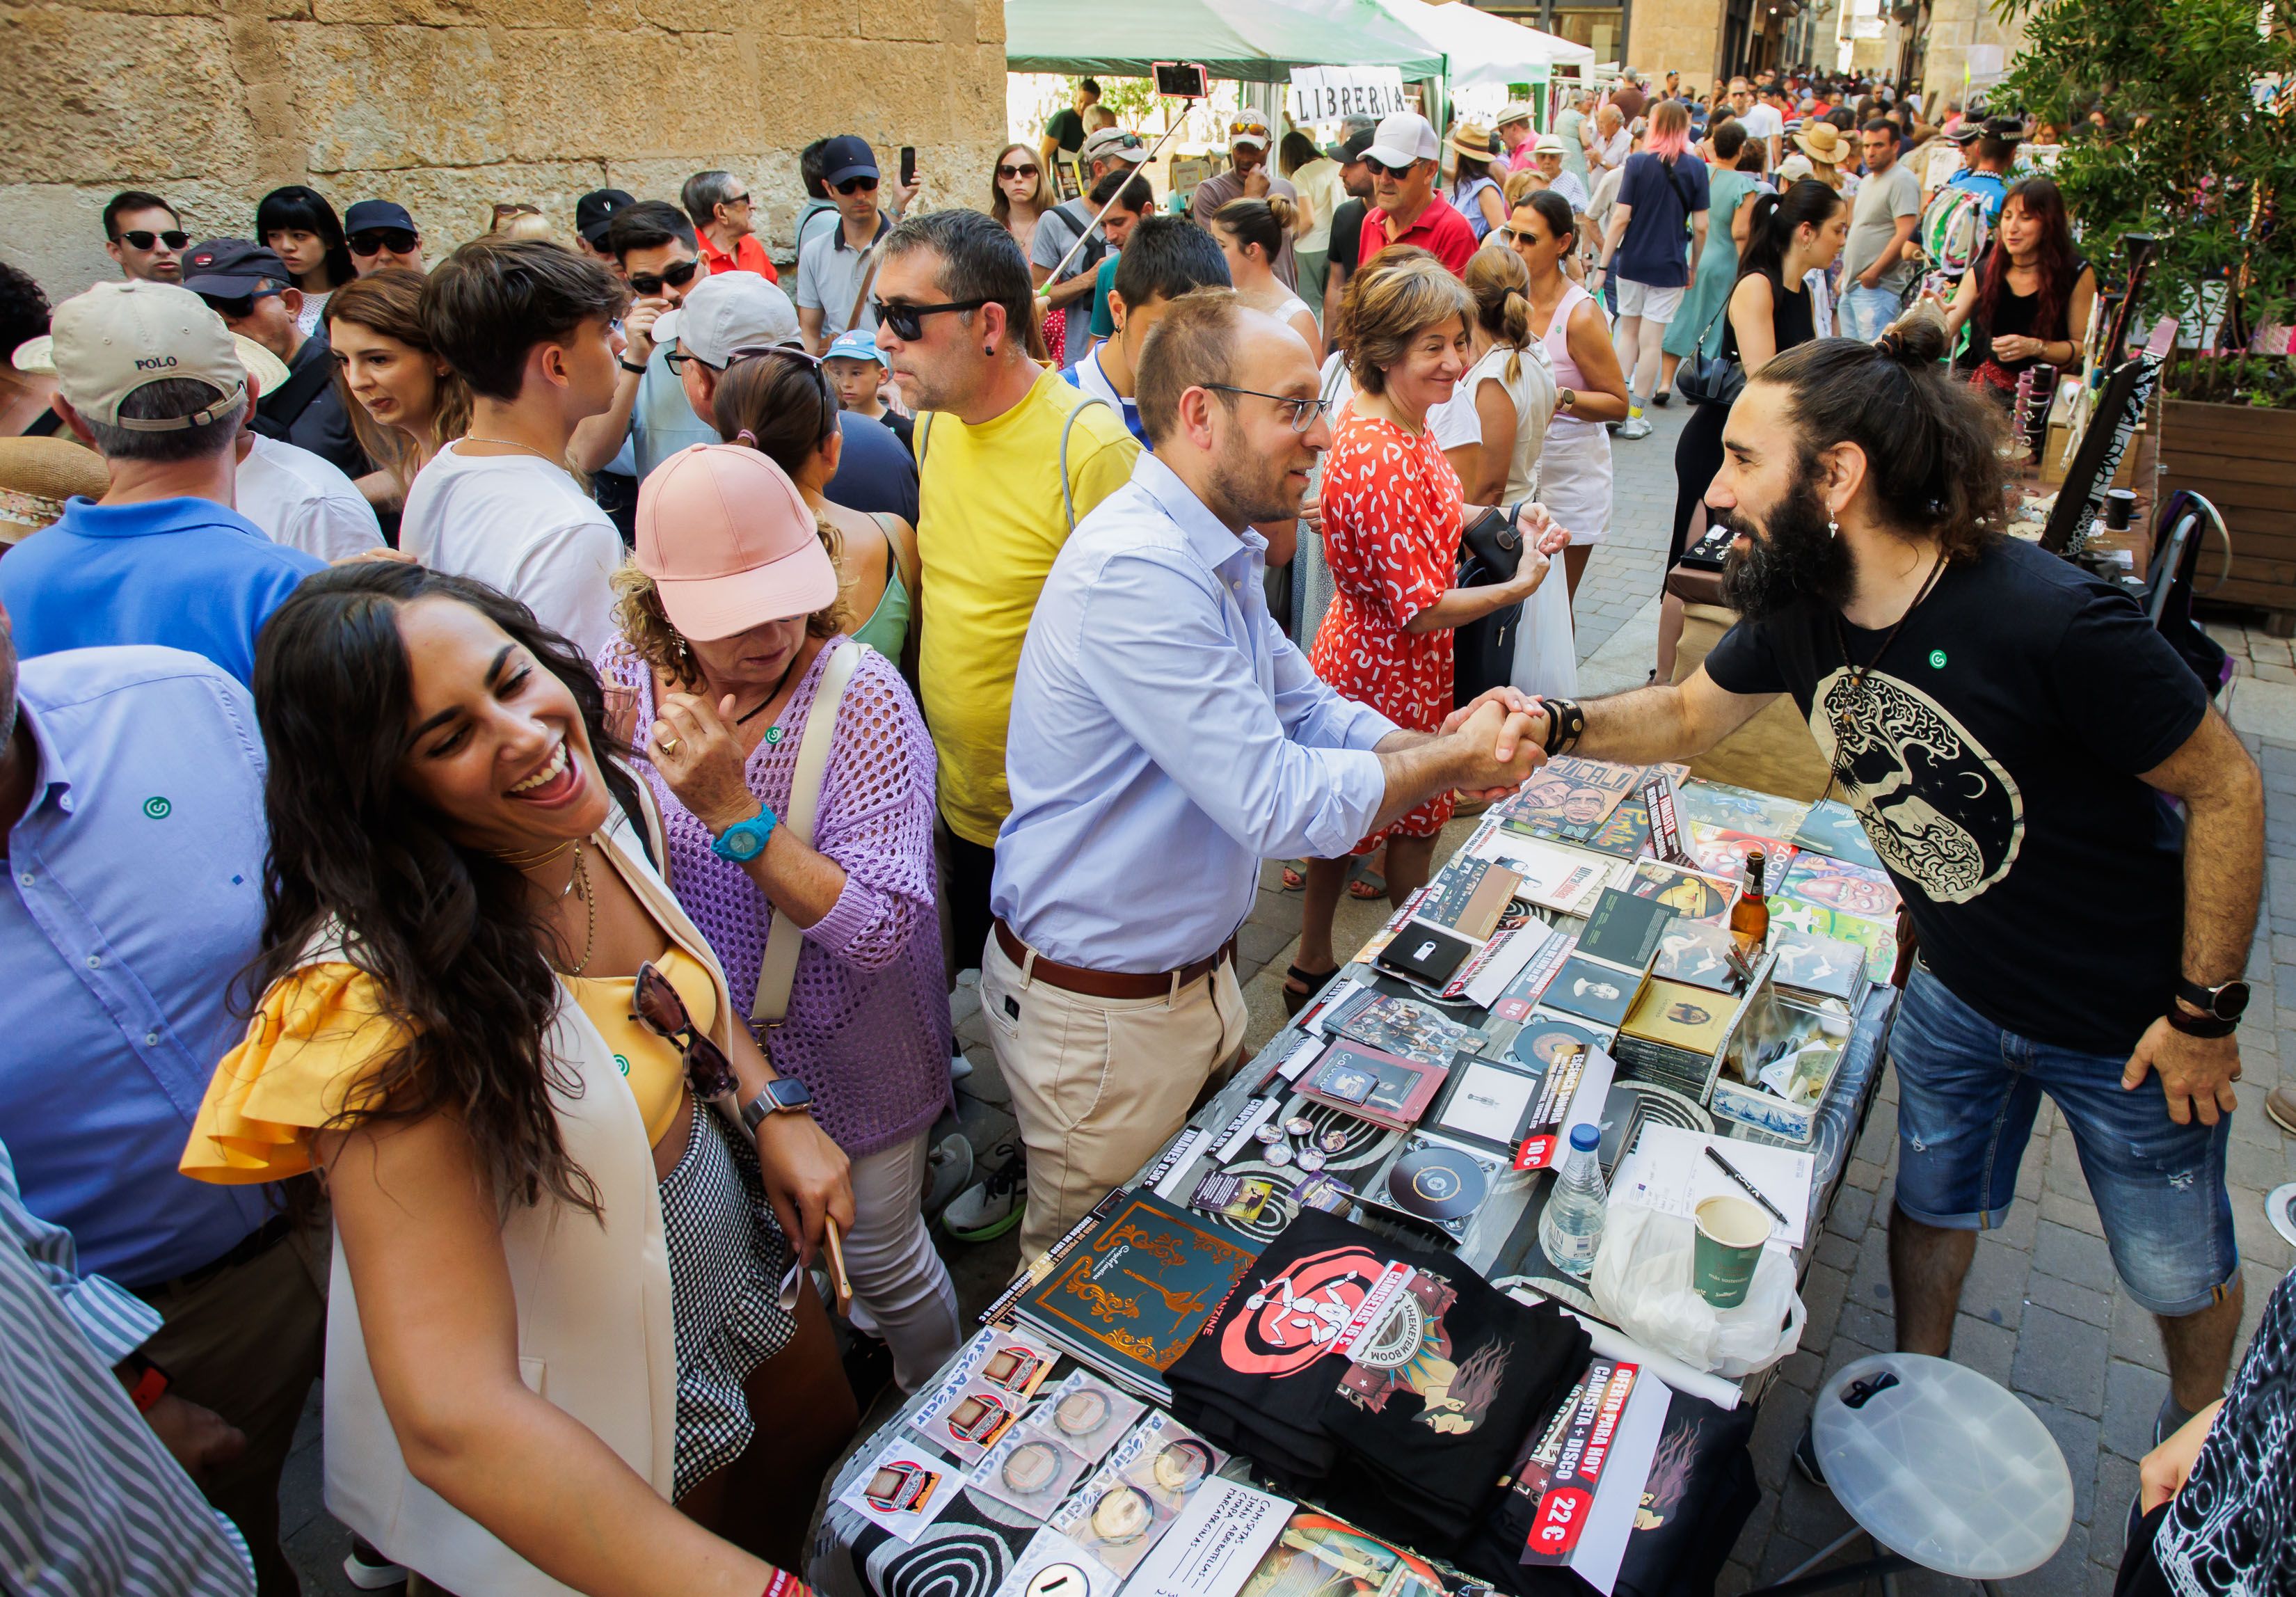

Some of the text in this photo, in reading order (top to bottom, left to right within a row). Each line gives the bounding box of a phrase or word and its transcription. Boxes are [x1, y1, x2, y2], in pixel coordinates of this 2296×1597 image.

[135, 356, 177, 370] POLO
[1227, 1099, 1263, 1133] CHAPAS
[1549, 1090, 1571, 1125] SONORA
[1162, 1129, 1199, 1165] IMANES
[1524, 1139, 1546, 1166] 10 €
[1339, 1271, 1403, 1346] CAMISETAS 16 €
[1371, 1304, 1417, 1360] SHEKETEM BOOM
[1574, 1365, 1611, 1426] CAMISETA
[1574, 1427, 1585, 1436] +
[1581, 1369, 1632, 1475] OFERTA PARA HOY
[1556, 1438, 1584, 1480] DISCO
[1225, 1492, 1247, 1518] CHAPA
[1542, 1496, 1577, 1541] 22 €
